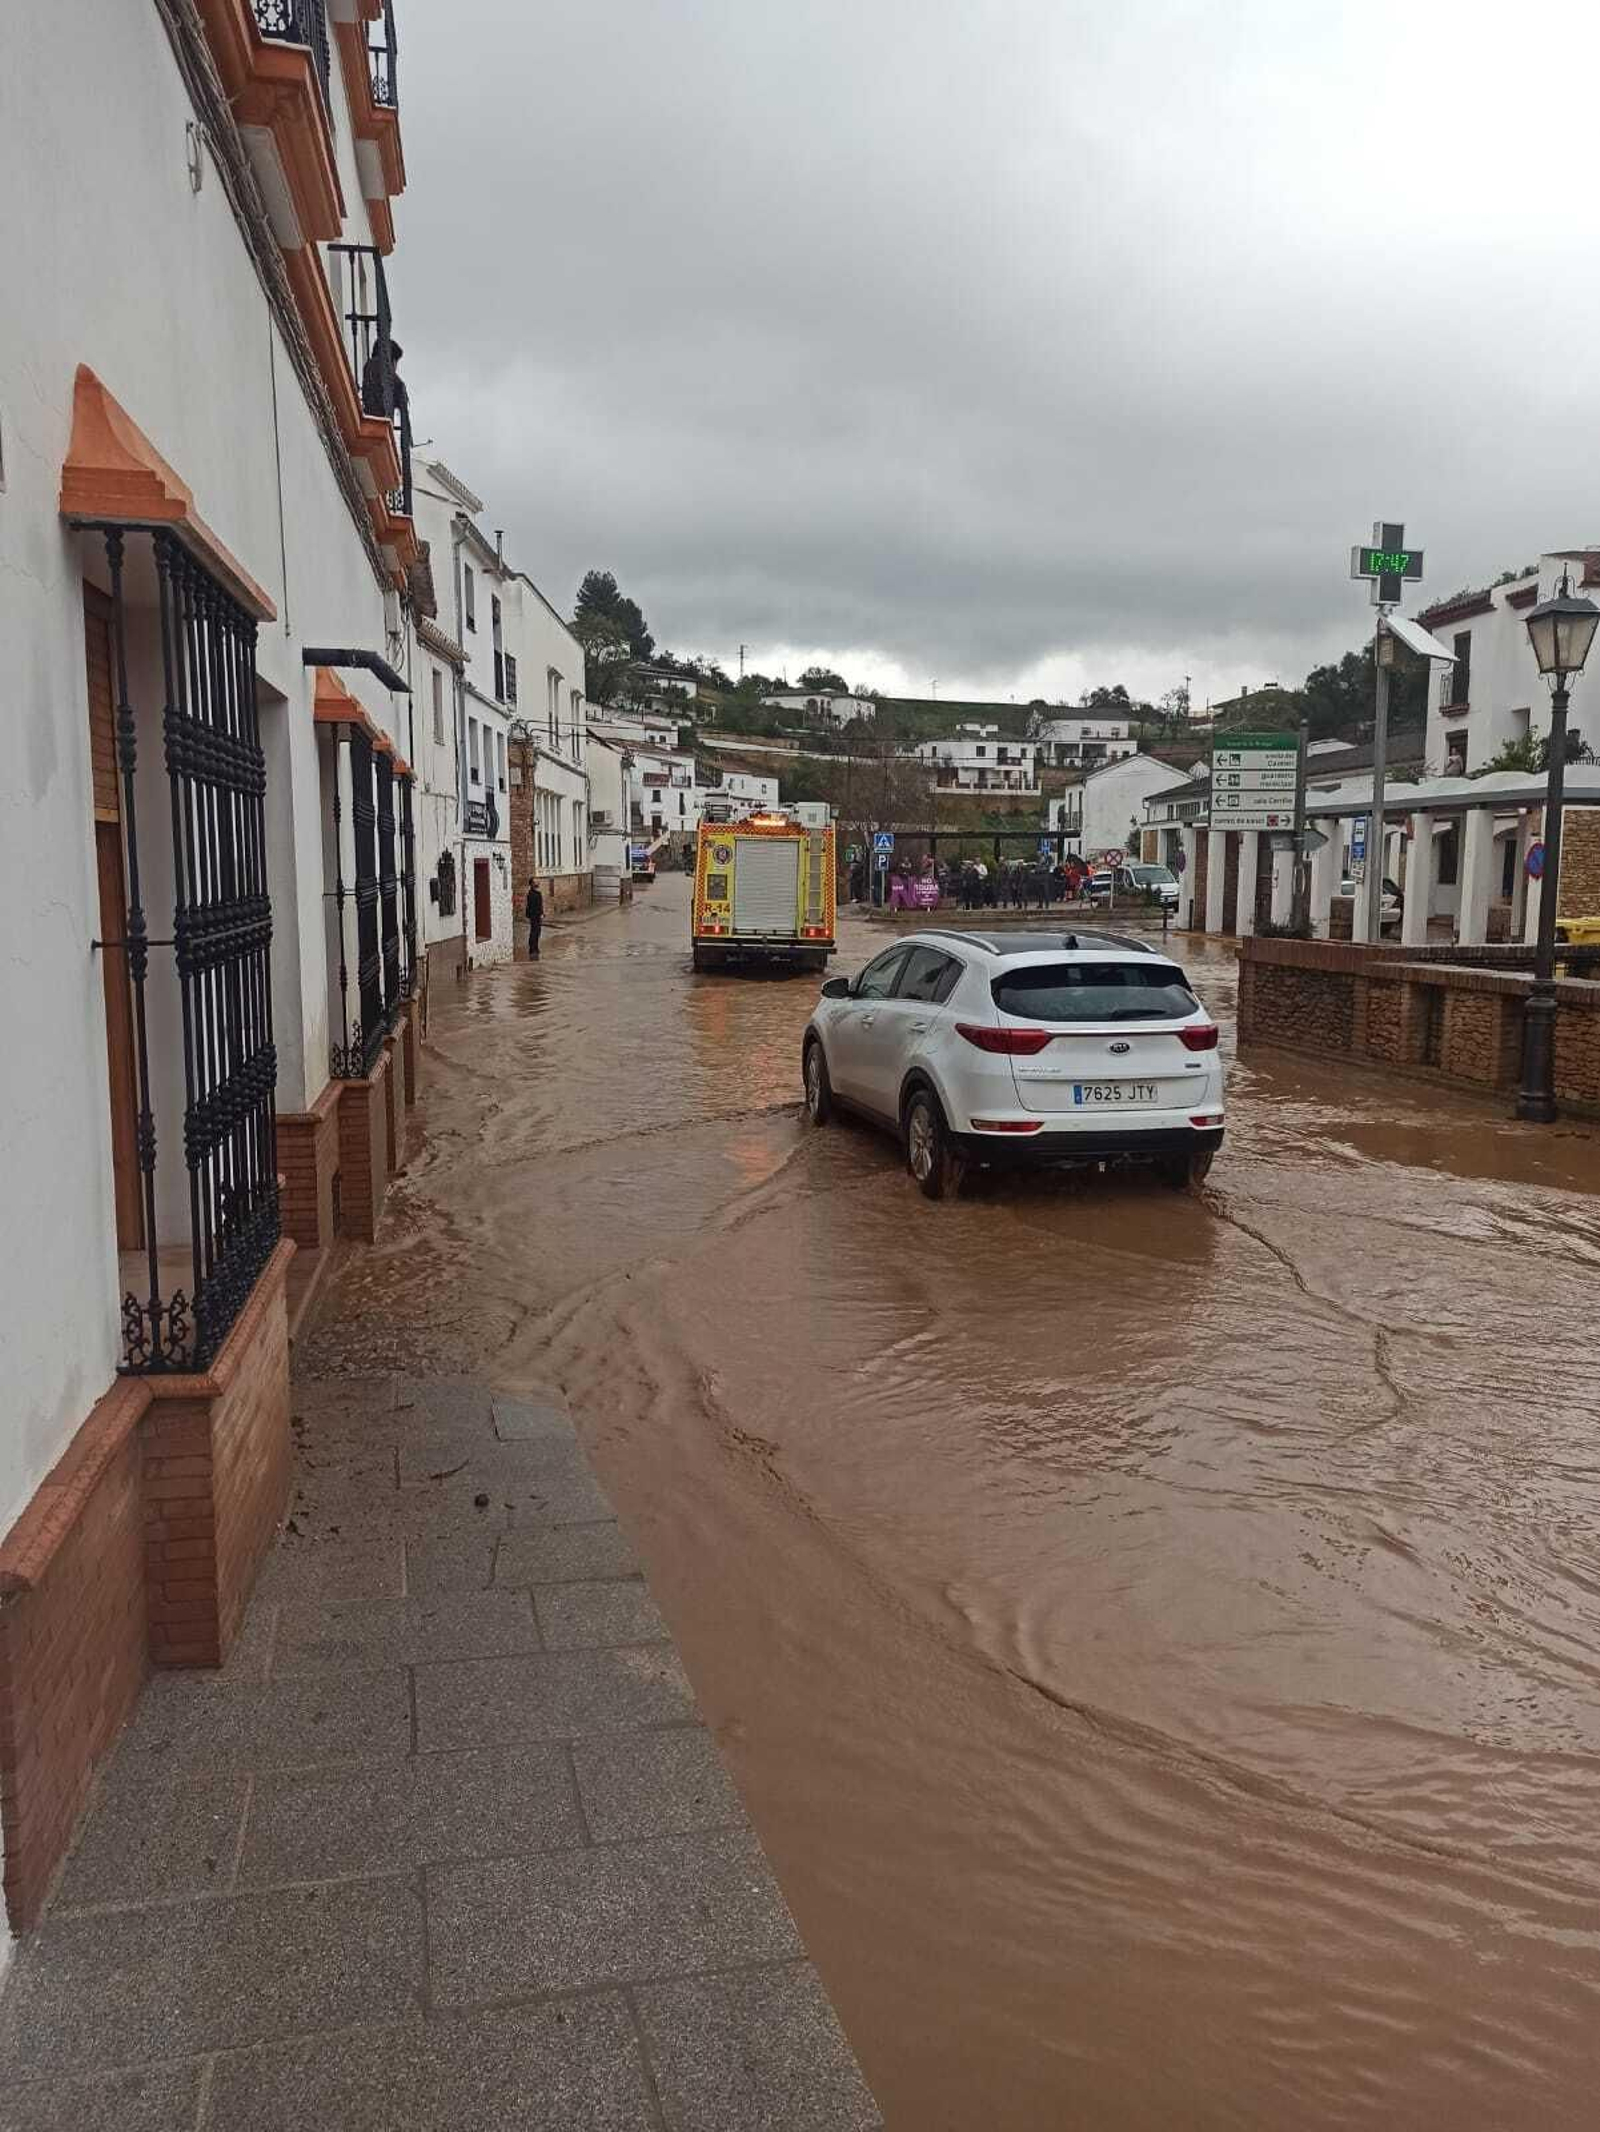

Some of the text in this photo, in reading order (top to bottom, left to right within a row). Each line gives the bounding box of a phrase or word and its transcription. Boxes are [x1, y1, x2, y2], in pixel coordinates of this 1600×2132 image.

[1369, 552, 1409, 573] 17:47
[878, 854, 887, 868] P
[1084, 1085, 1154, 1101] 7625 JTY
